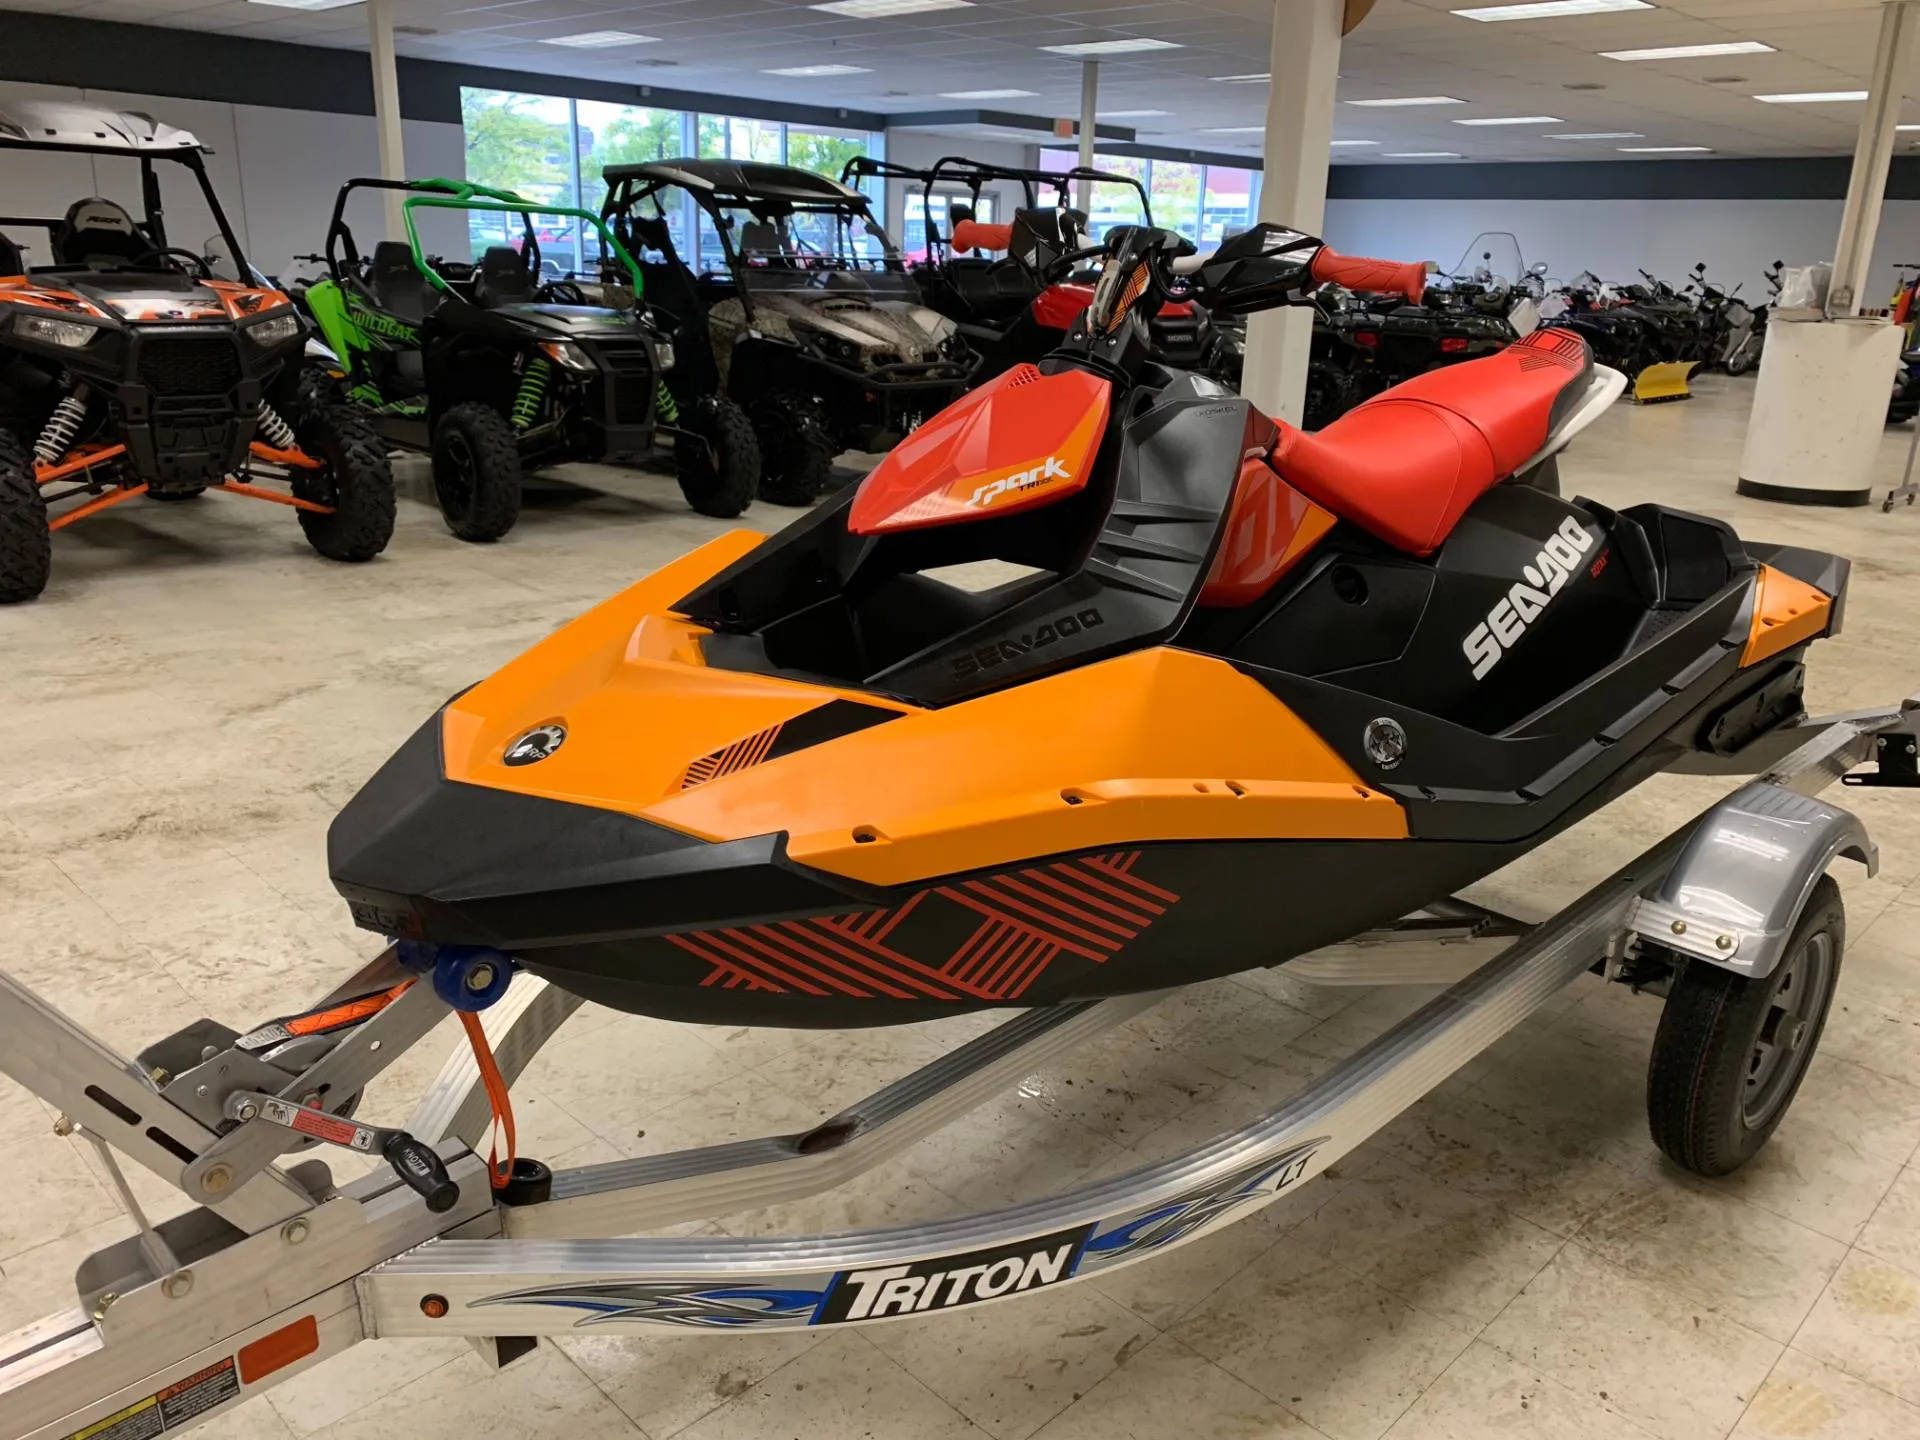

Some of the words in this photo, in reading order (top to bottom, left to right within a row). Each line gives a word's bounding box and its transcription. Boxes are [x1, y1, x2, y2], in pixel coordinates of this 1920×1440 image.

[352, 310, 417, 340] WILDCAT
[1275, 1150, 1318, 1191] LT
[846, 1243, 1074, 1321] TRITON
